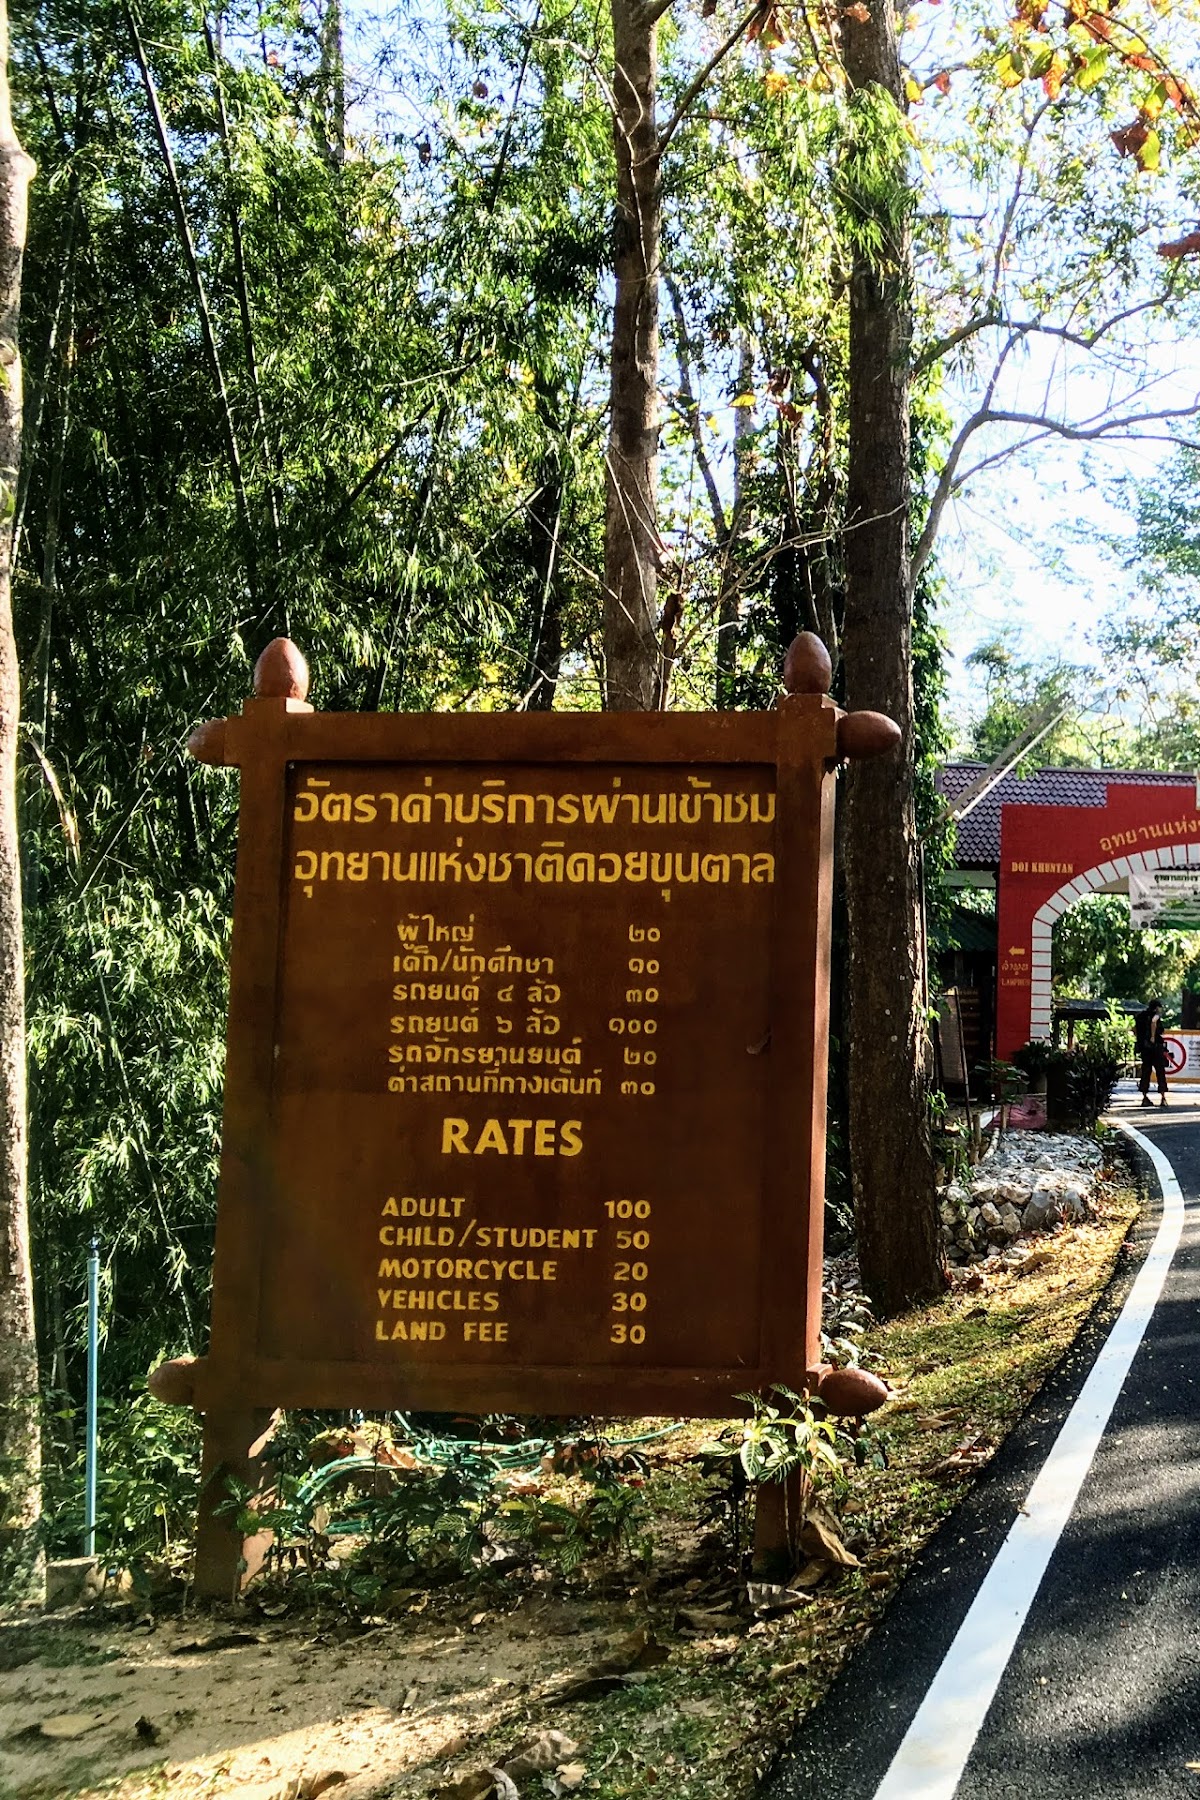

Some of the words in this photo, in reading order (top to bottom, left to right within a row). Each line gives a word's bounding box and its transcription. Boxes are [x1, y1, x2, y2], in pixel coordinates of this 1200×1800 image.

[294, 776, 776, 824] อัตราค่าบริการผ่านเข้าชม
[294, 836, 775, 902] อุทยานแห่งชาติดอยขุนตาล
[1011, 861, 1029, 873] DOI
[1031, 861, 1074, 874] KHUNTAN
[396, 913, 475, 951] ผู้ใหญ่
[628, 924, 661, 943] ๒๐
[393, 944, 554, 974] เด็ก/นักศึกษา
[628, 957, 660, 974] ๑๐
[392, 976, 480, 1001] รถยนต์
[625, 987, 659, 1003] ๓๐
[390, 1007, 479, 1034] รถยนต์
[608, 1017, 658, 1035] ๑๐๐
[388, 1036, 582, 1065] รถจักรยานยนต์
[623, 1047, 657, 1066] ๒๐
[620, 1080, 656, 1096] ๓๐
[441, 1117, 583, 1157] RATES
[381, 1197, 466, 1218] ADULT
[604, 1199, 651, 1219] 100
[379, 1219, 598, 1249] CHILD/STUDENT
[616, 1230, 650, 1250] 50
[378, 1257, 558, 1281] MOTORCYCLE
[613, 1261, 648, 1282] 20
[377, 1289, 499, 1312] VEHICLES
[611, 1292, 647, 1312] 30
[375, 1320, 446, 1342] LAND
[463, 1322, 508, 1343] FEE
[610, 1323, 646, 1345] 30
